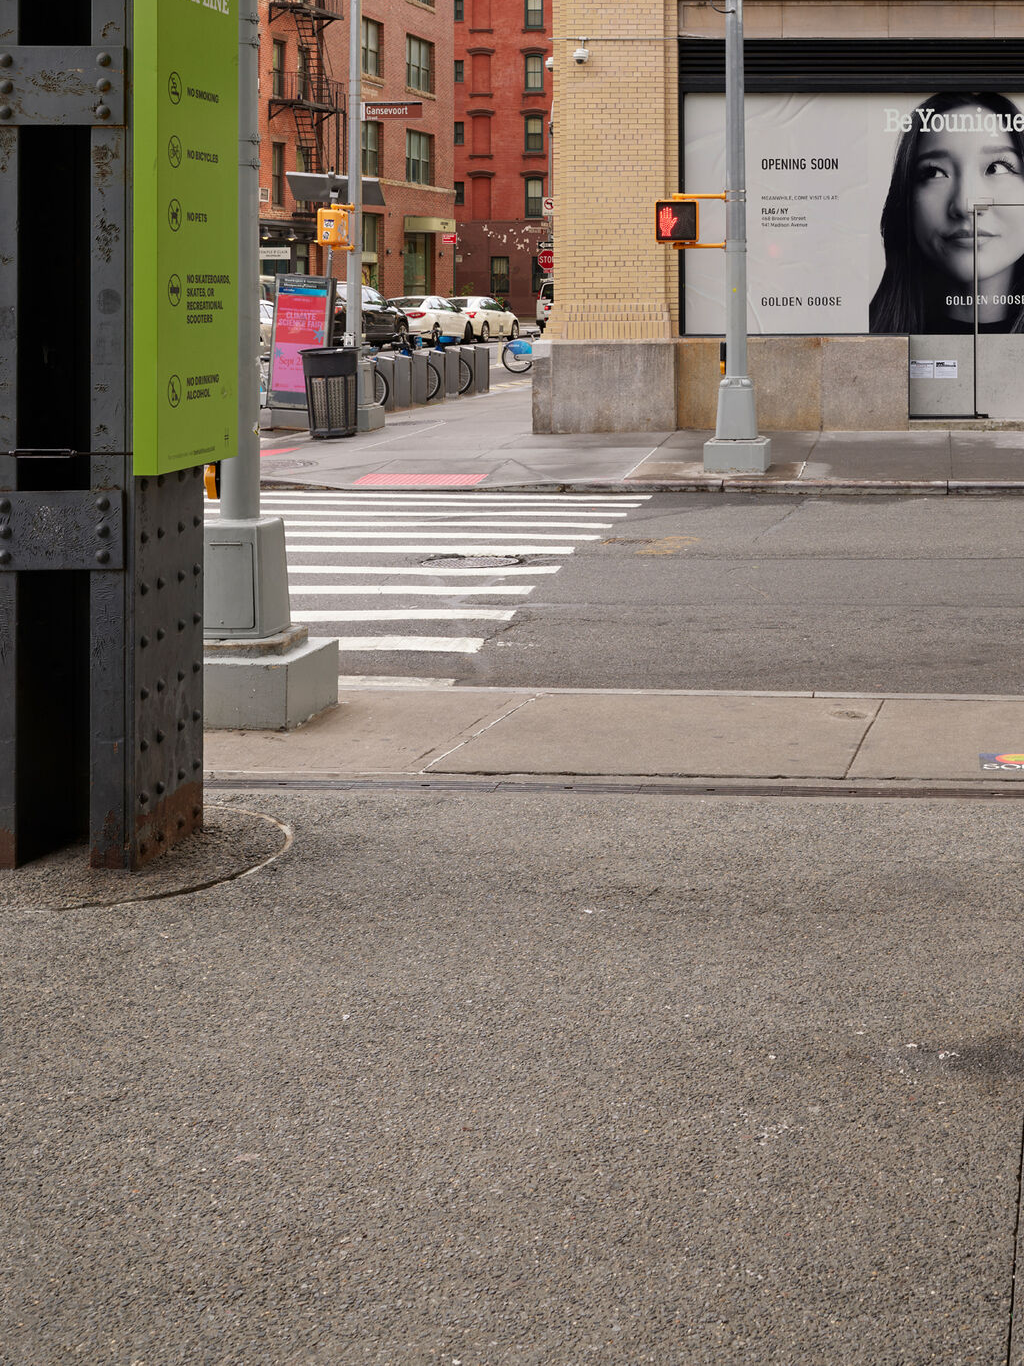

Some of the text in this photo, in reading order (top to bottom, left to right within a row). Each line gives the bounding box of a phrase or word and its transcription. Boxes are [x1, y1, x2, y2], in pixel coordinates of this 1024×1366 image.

[186, 87, 219, 104] NO SMOKING
[365, 105, 409, 115] Gansevoort
[883, 108, 913, 133] Be
[186, 149, 219, 164] NO BICYCLES
[761, 157, 839, 171] OPENING SOON
[186, 211, 208, 223] NO PETS
[186, 273, 231, 285] NO SKATEBOARDS,
[207, 287, 215, 297] OR
[186, 300, 224, 311] RECREATIONAL
[761, 295, 842, 307] GOLDEN GOOSE
[945, 294, 988, 306] GOLDEN
[186, 314, 213, 324] SCOOTERS
[186, 373, 220, 387] NO DRINKING
[186, 388, 211, 401] ALCOHOL
